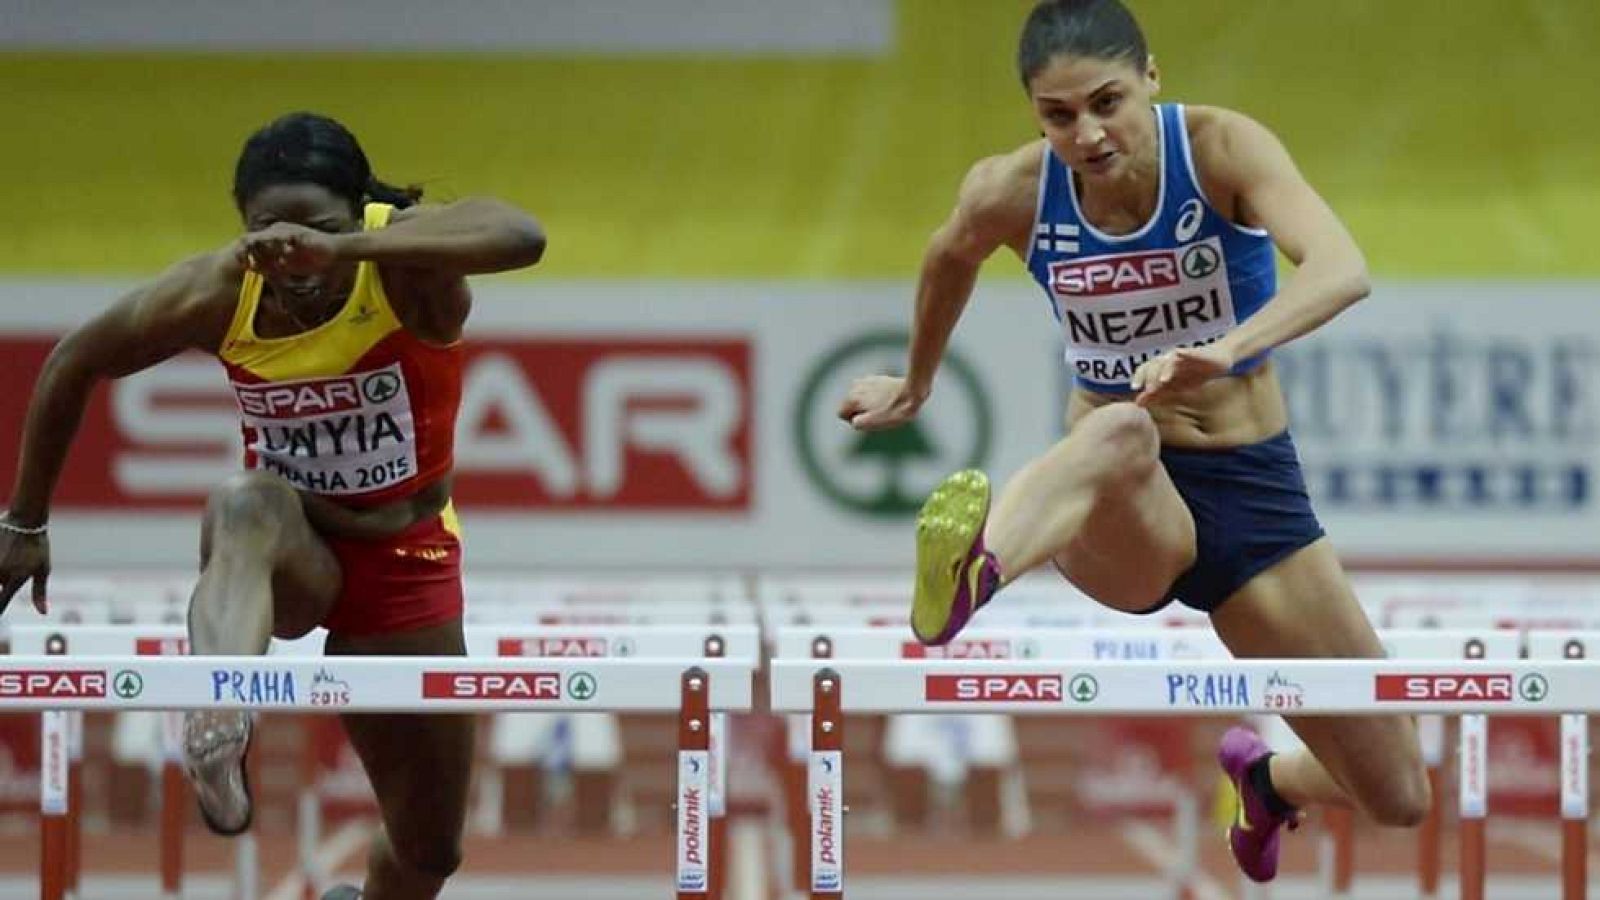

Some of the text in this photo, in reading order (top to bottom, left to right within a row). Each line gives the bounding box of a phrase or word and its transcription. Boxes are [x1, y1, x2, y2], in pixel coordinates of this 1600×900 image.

[1056, 255, 1177, 293] SPAR
[1066, 288, 1222, 345] NEZIRI
[1076, 349, 1161, 380] PRAH
[238, 382, 360, 416] SPAR
[111, 355, 740, 498] SAR
[262, 411, 406, 458] UNYIA
[355, 457, 411, 488] 2015
[0, 675, 104, 694] SPAR
[211, 669, 296, 704] PRAHA
[310, 691, 350, 705] 2015
[453, 675, 559, 696] SPAR
[956, 678, 1061, 699] SPAR
[1166, 673, 1250, 707] PRAHA
[1264, 694, 1304, 708] 2015
[1405, 677, 1511, 697] SPAR
[683, 786, 704, 865] polanik
[815, 784, 838, 865] polanik
